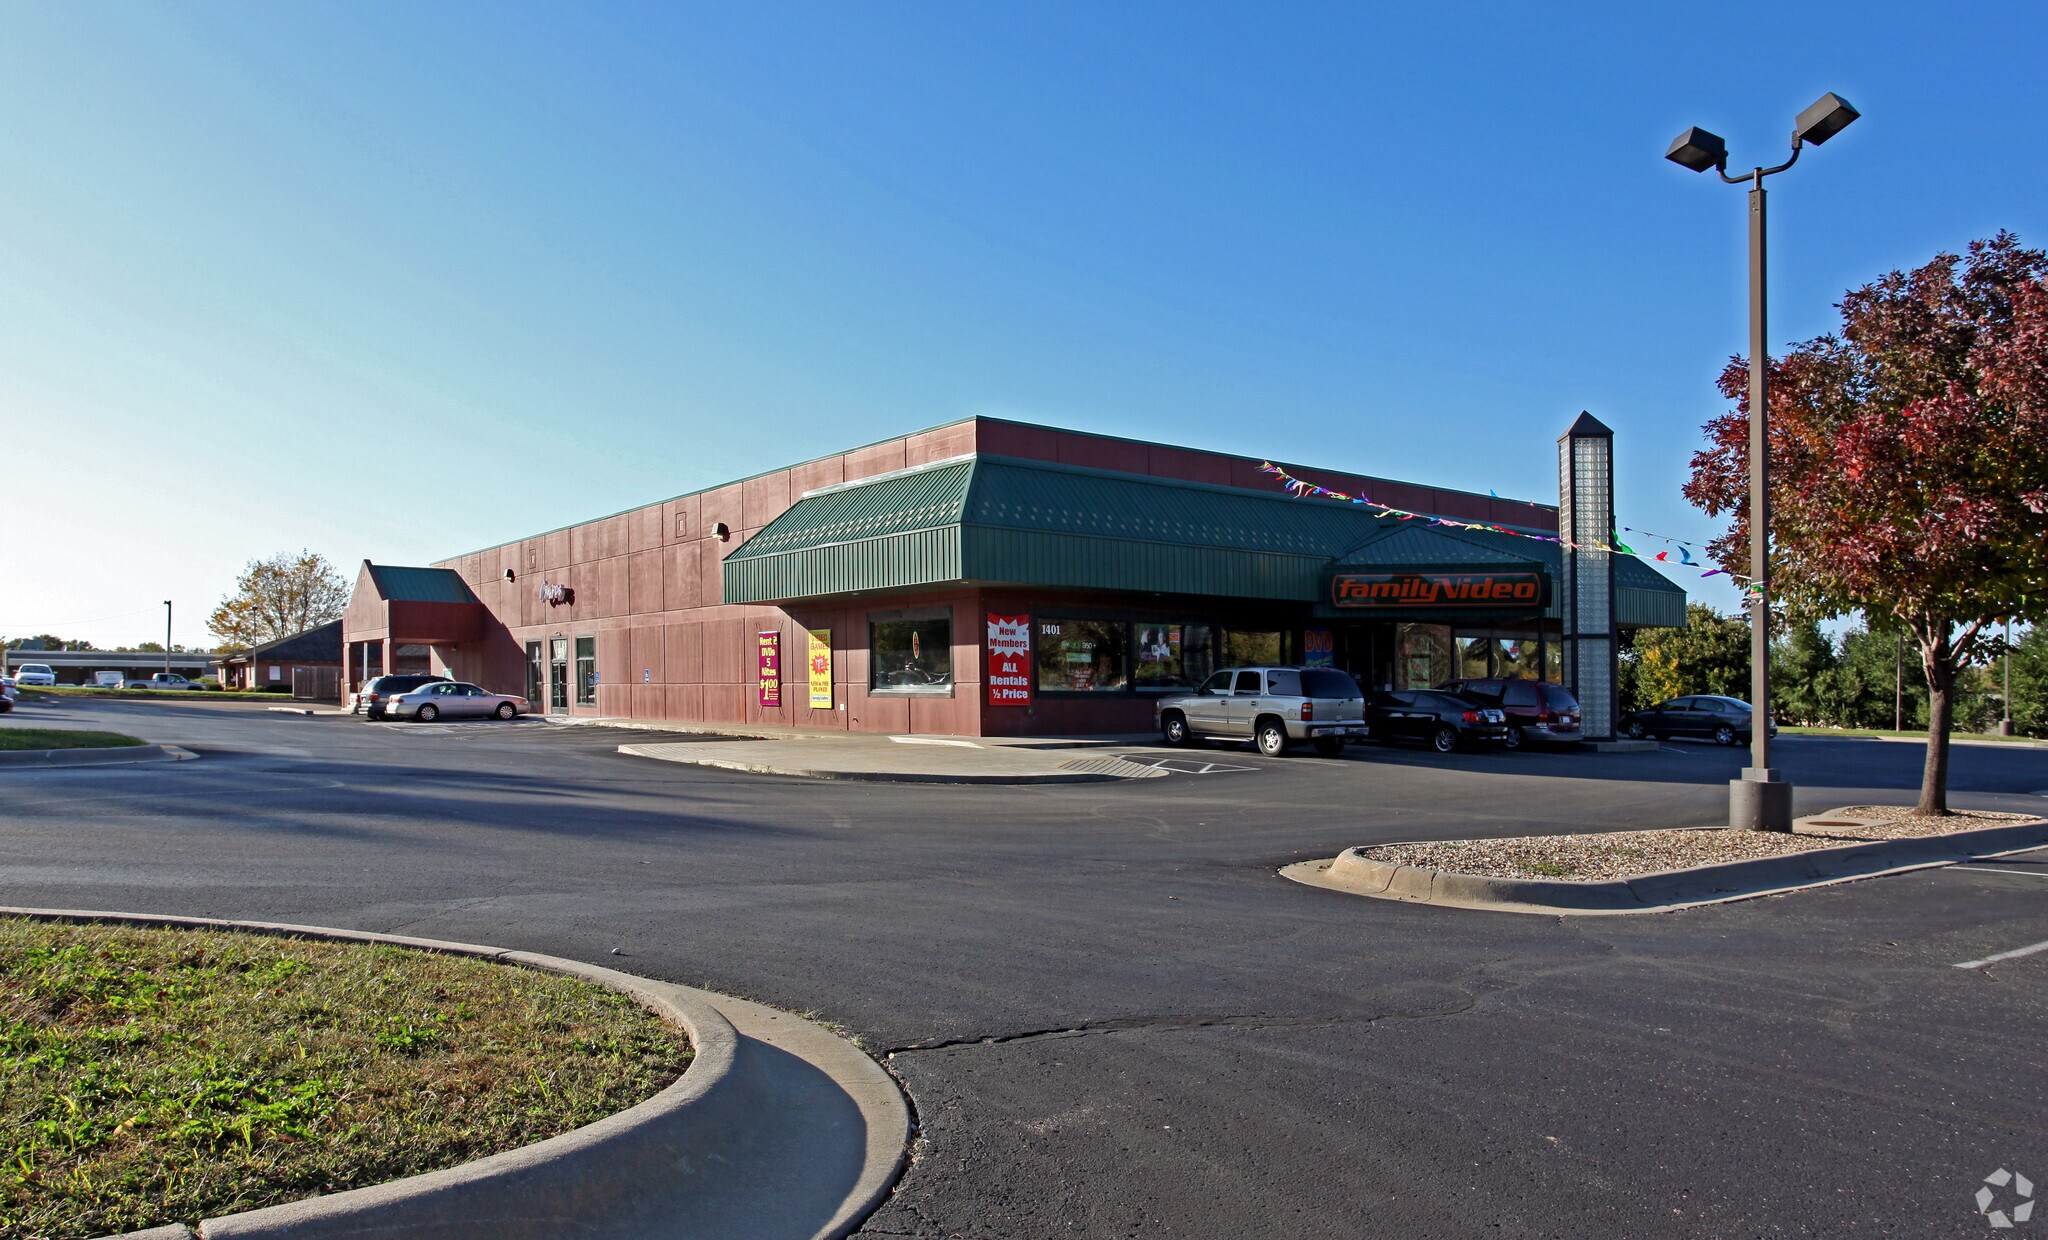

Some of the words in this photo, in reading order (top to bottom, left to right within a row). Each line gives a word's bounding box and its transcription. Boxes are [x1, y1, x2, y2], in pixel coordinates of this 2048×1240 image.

[999, 627, 1016, 636] New
[1042, 624, 1060, 635] 1401
[760, 637, 772, 645] Rent
[773, 636, 777, 645] 2
[989, 638, 1027, 648] Members
[762, 648, 775, 656] DVDs
[766, 658, 770, 666] 5
[762, 667, 776, 676] Nites
[1002, 662, 1018, 673] ALL
[990, 675, 1028, 686] Rentals
[1002, 688, 1028, 699] Price
